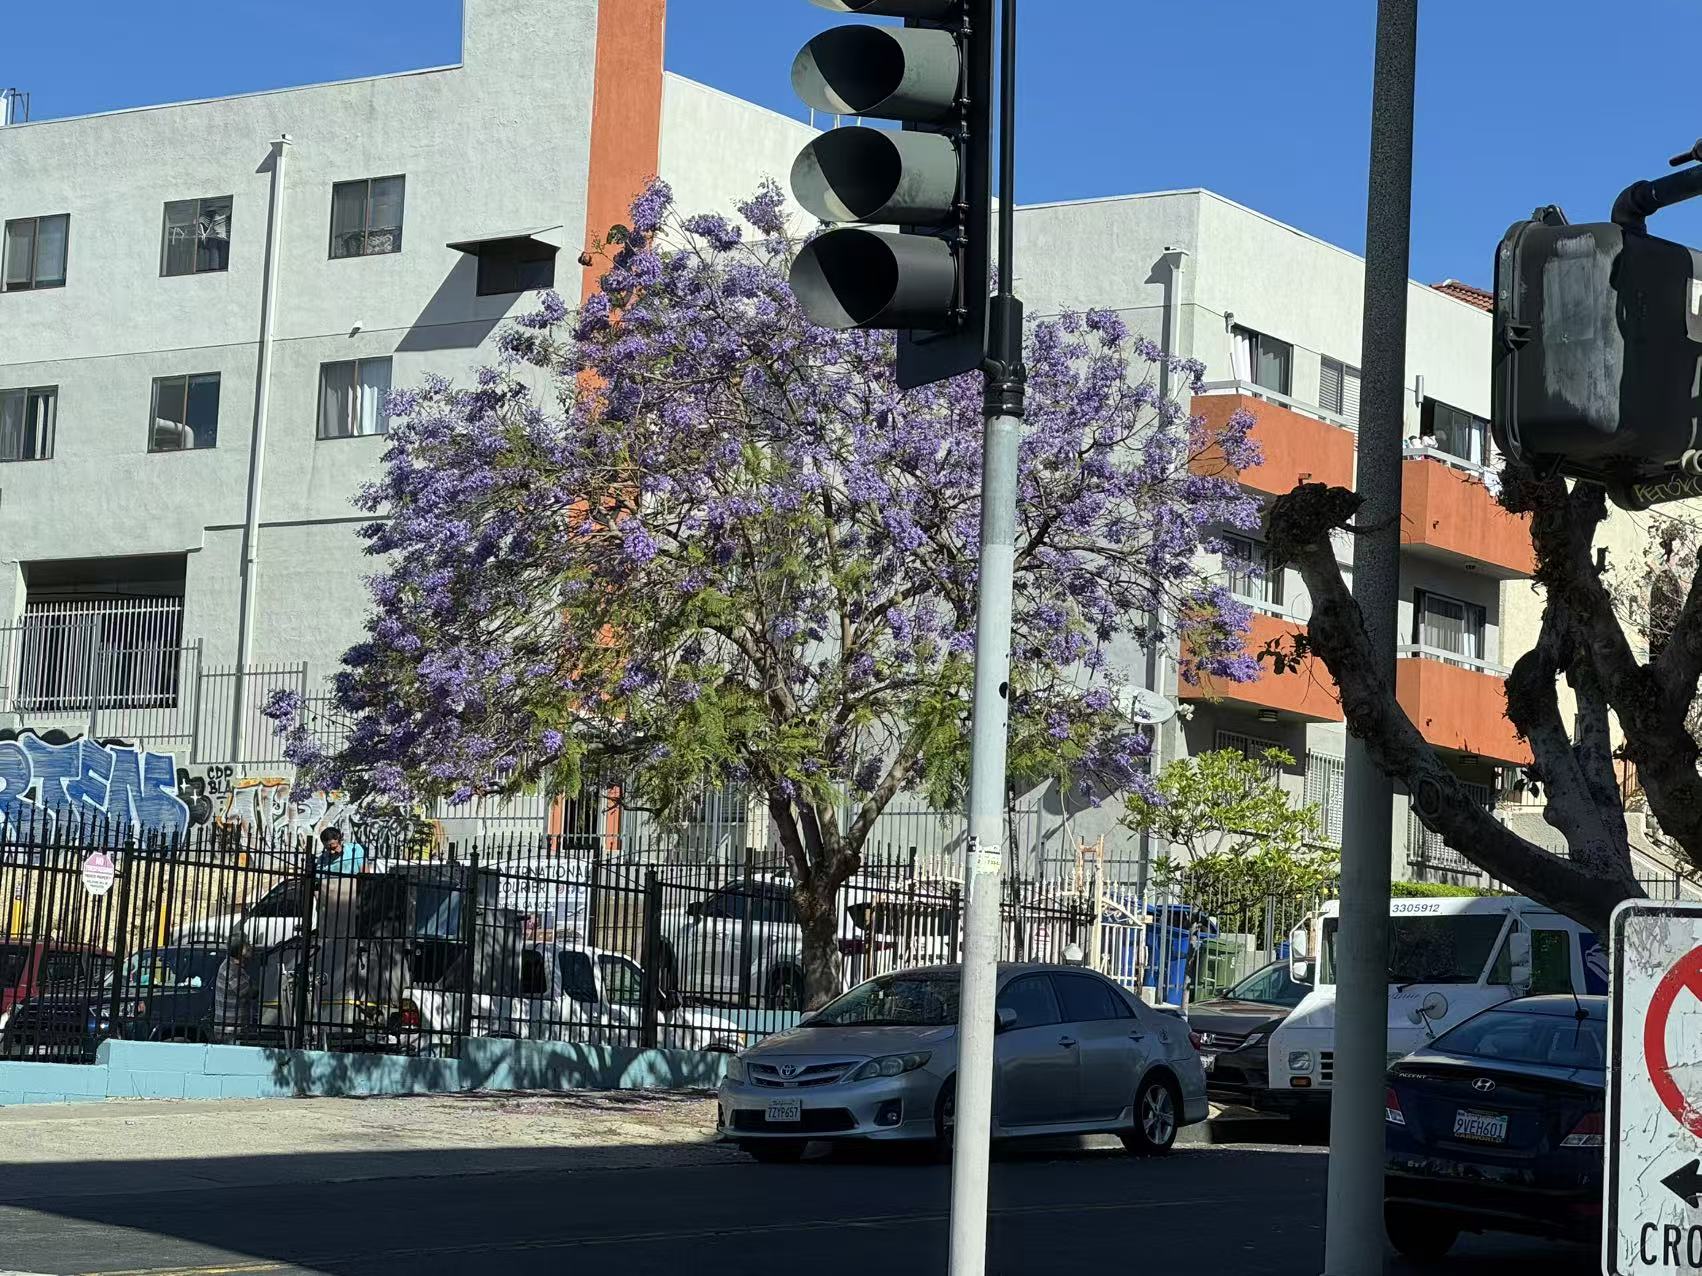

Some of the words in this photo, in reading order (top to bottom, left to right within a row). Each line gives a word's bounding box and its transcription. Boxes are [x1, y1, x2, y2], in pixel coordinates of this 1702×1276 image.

[497, 865, 592, 879] NTERNATIONAL
[1392, 903, 1440, 913] 3305912
[1455, 1118, 1503, 1137] 9VEH601
[1639, 1221, 1702, 1269] CRO
